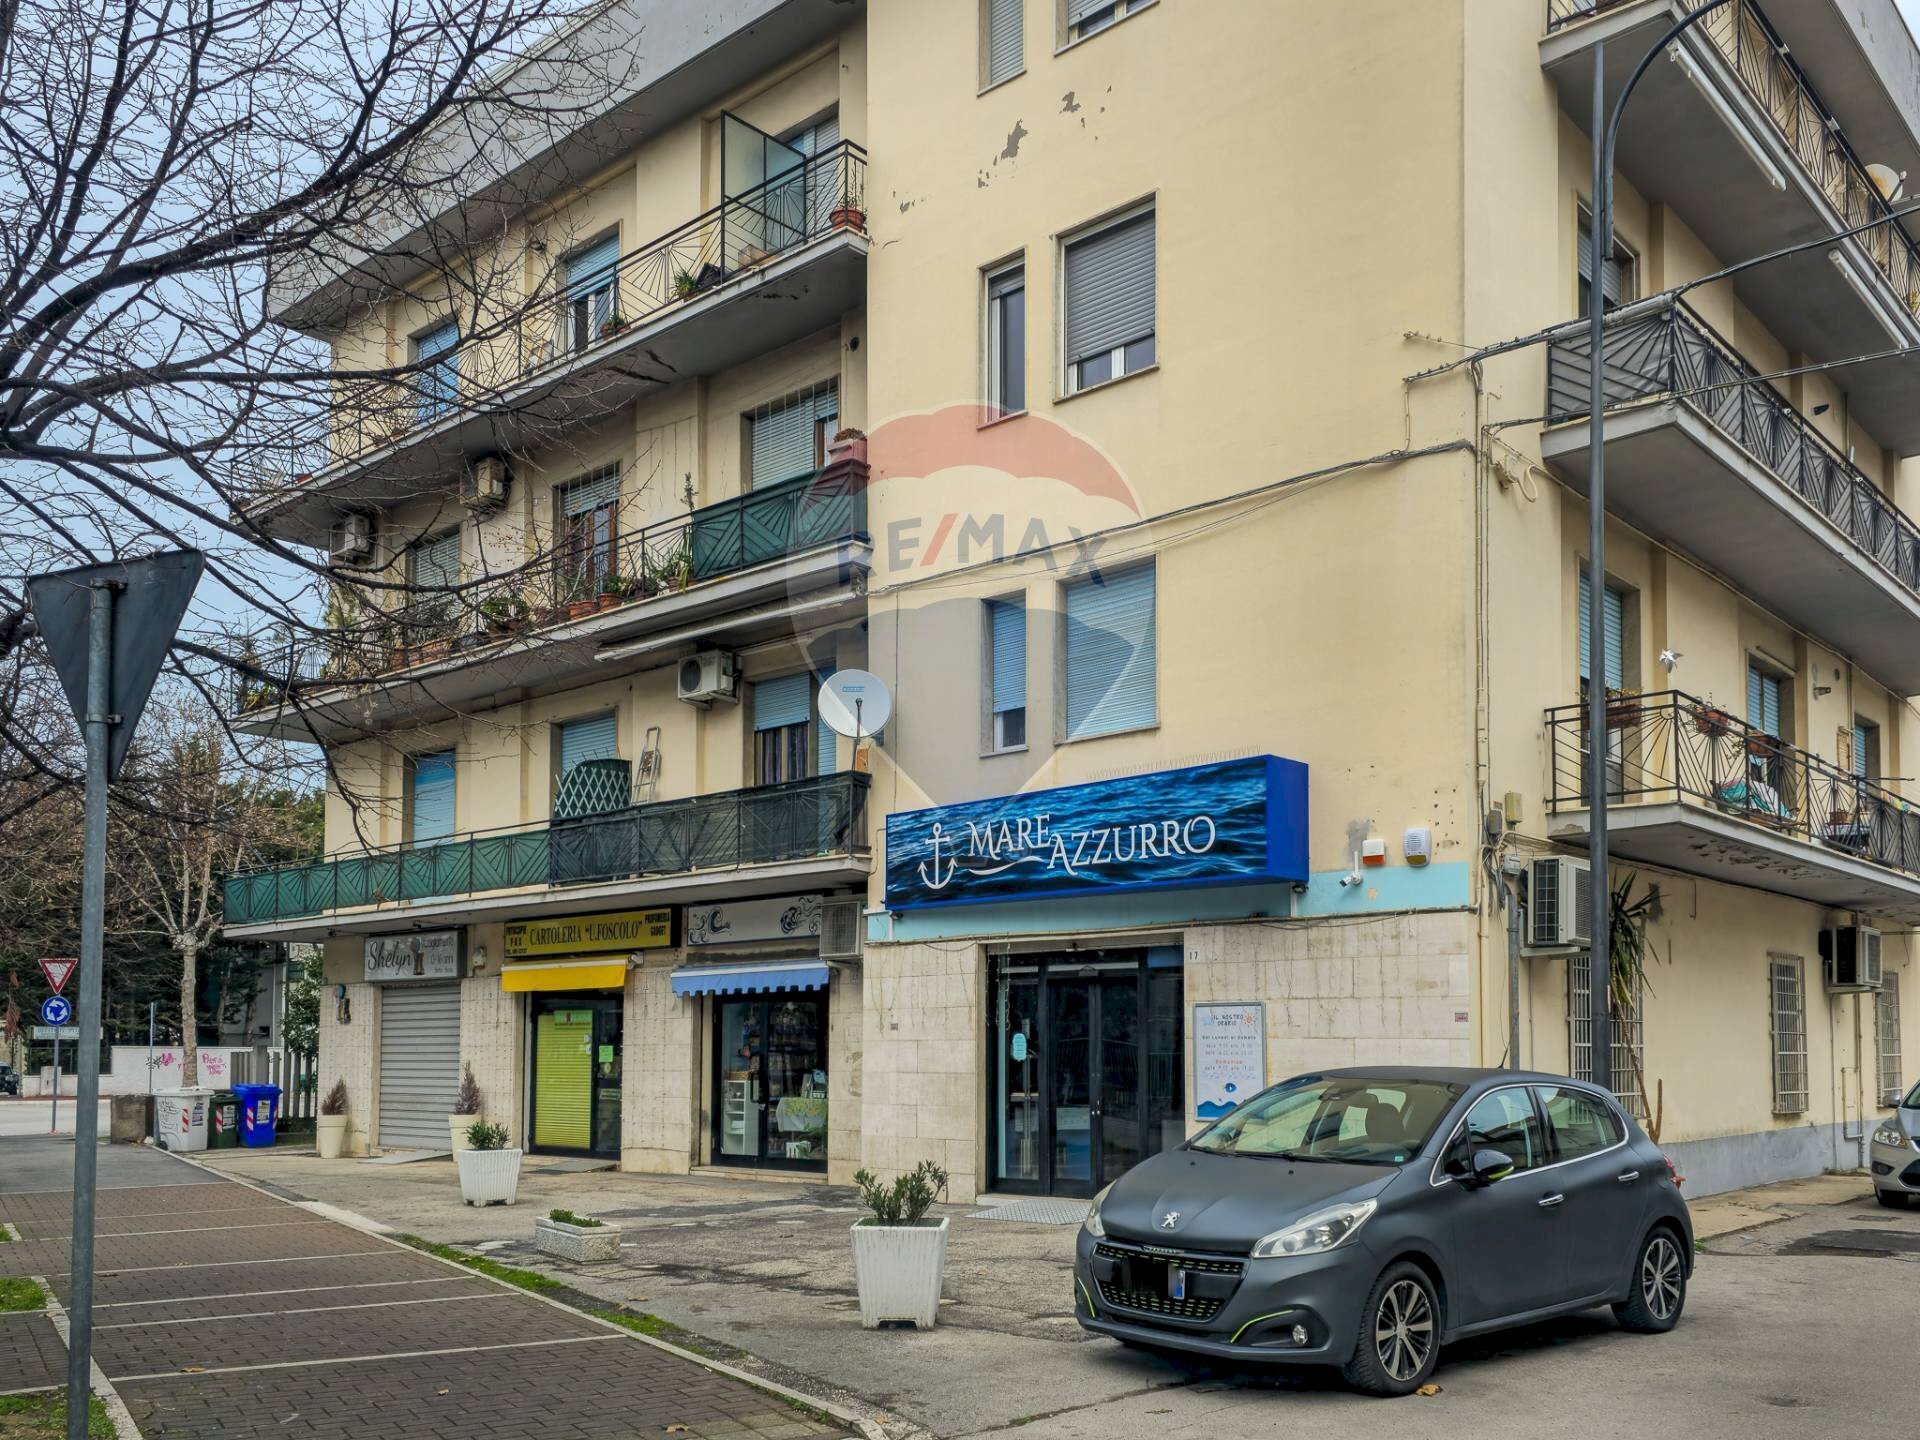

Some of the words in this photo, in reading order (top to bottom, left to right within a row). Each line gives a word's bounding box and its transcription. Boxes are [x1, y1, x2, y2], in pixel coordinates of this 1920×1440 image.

[965, 814, 1051, 861] MARE
[1047, 815, 1216, 876] AZZURRO
[530, 925, 582, 945] CARTOLERIA
[368, 941, 411, 975] Shelyn
